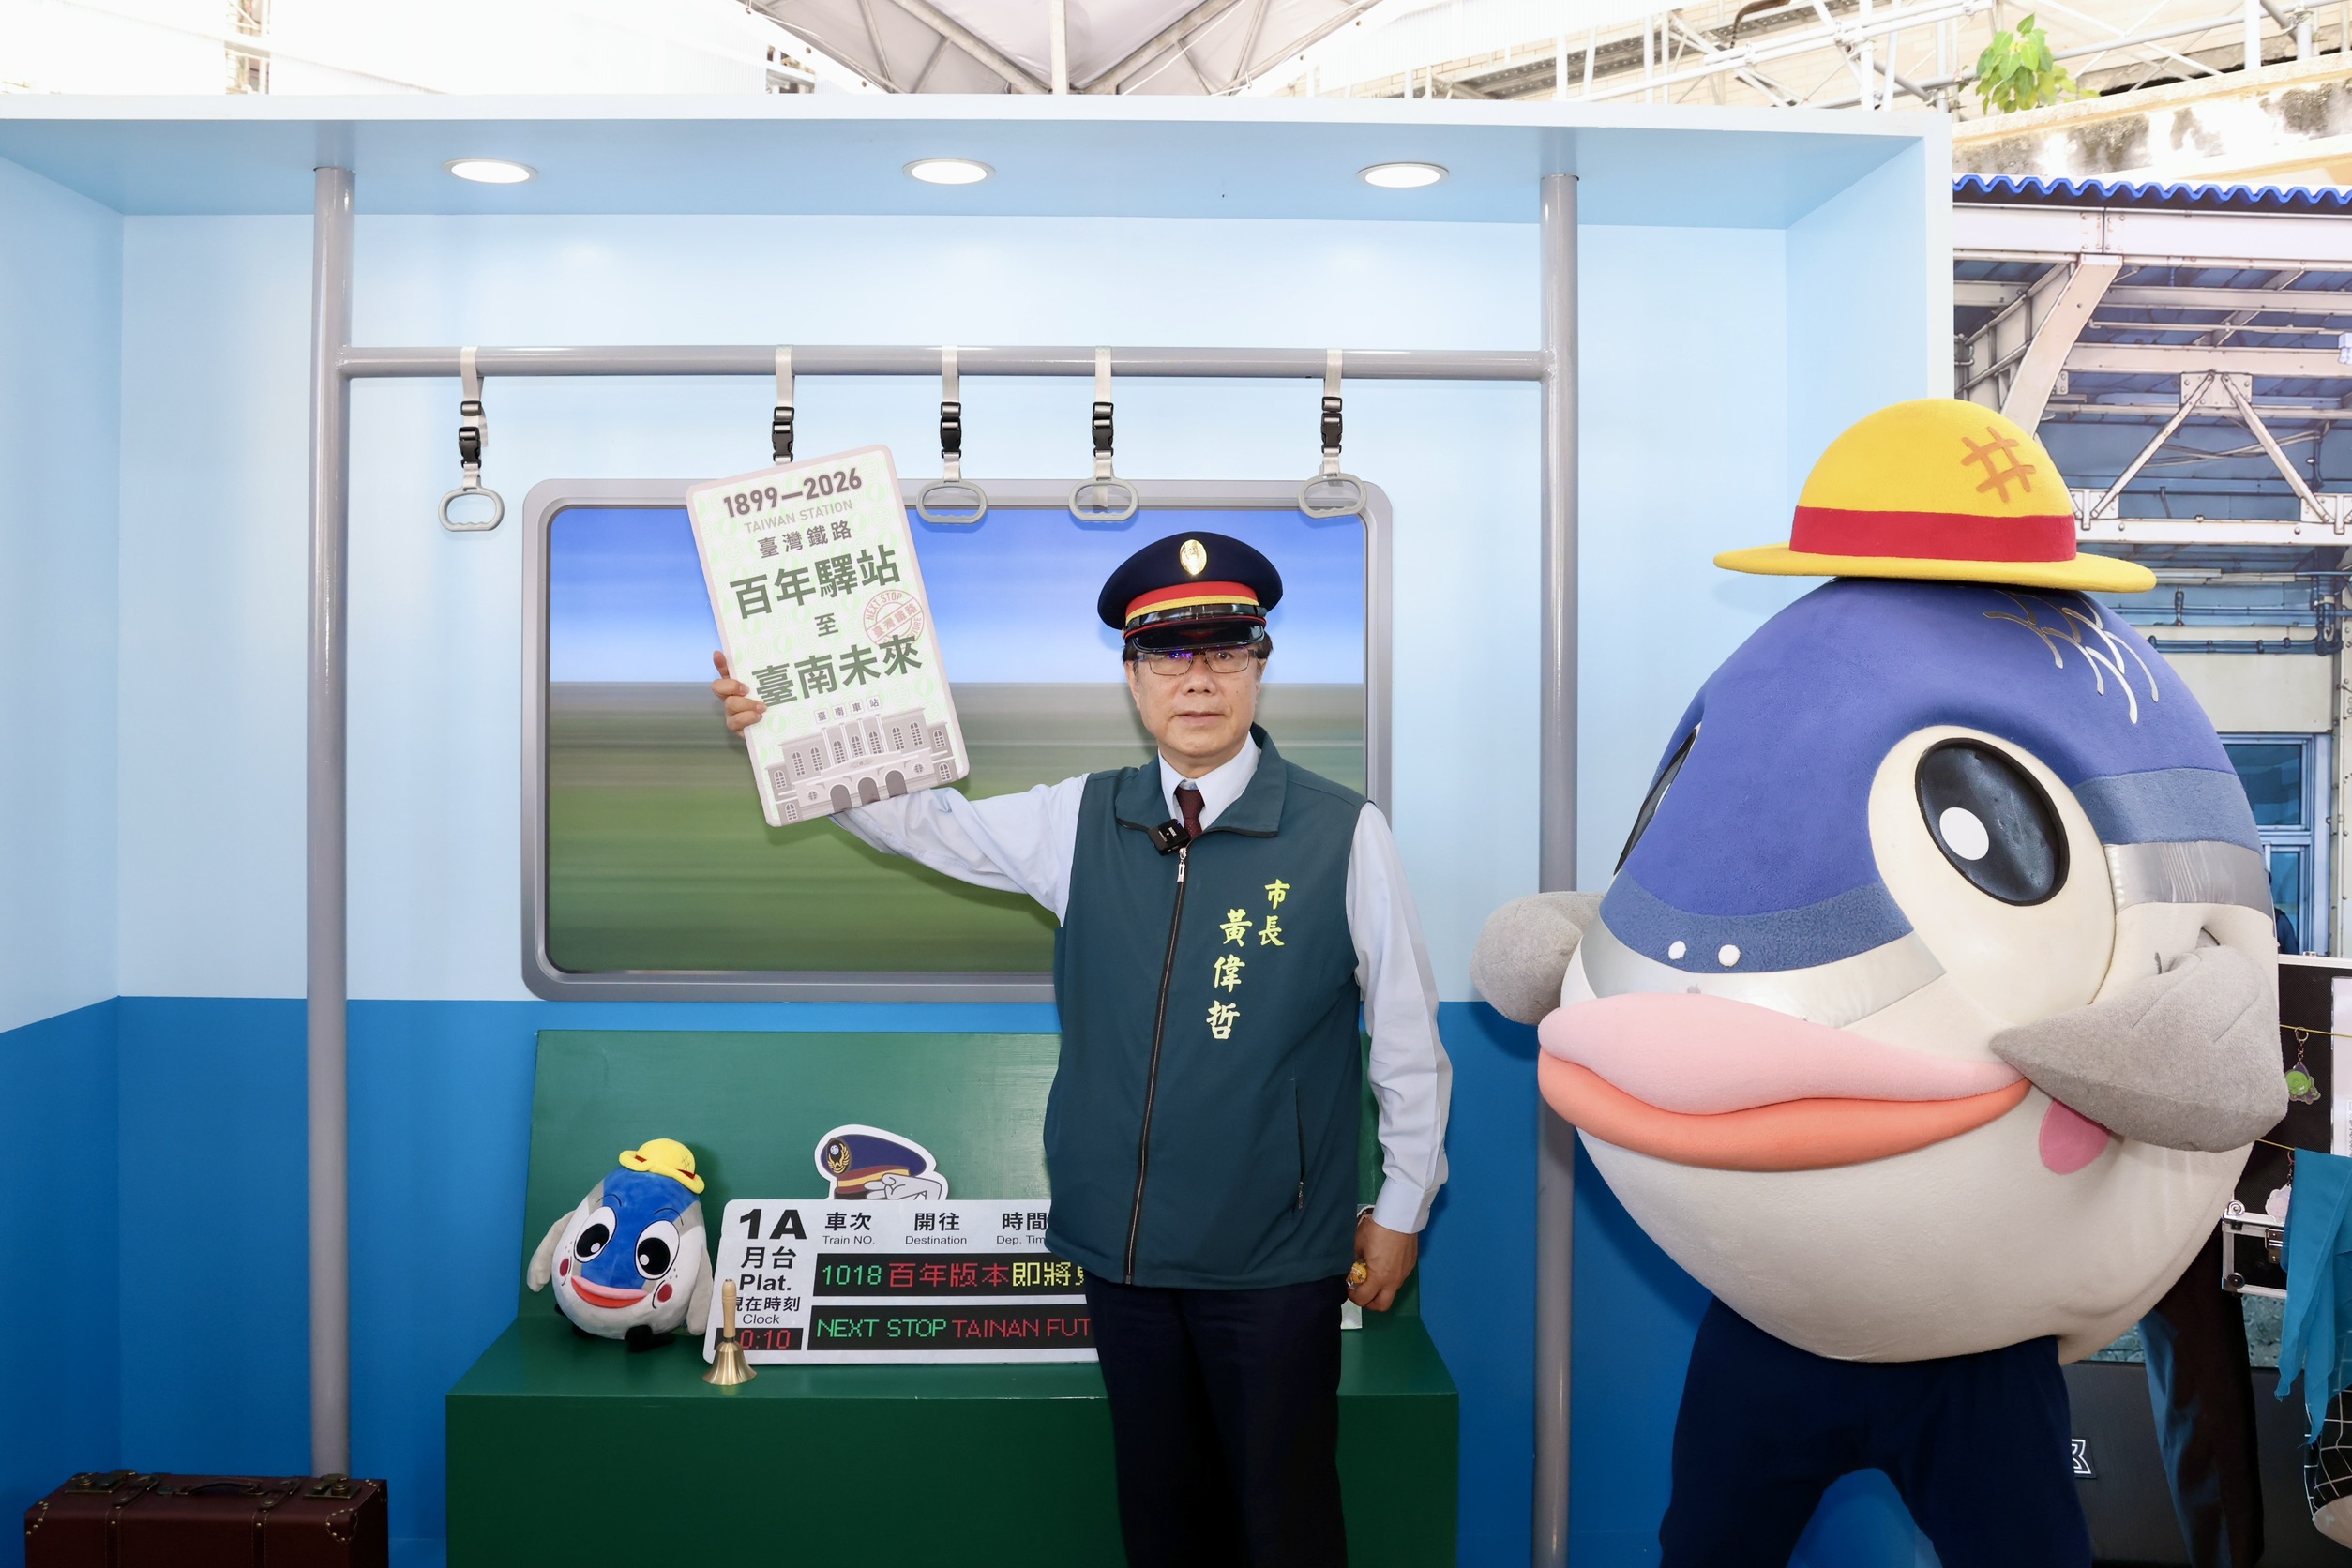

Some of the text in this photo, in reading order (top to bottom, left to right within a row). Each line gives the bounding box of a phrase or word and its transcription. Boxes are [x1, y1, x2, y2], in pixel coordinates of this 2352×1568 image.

[744, 499, 853, 534] TAIWAN STATION
[758, 520, 852, 559] 臺灣鐵路
[730, 544, 900, 619] 百年驛站
[866, 592, 902, 620] NEXT STOP
[814, 612, 839, 638] 至
[751, 635, 923, 708] 臺南未來
[817, 698, 880, 722] 臺南車站
[1258, 878, 1290, 947] 市長
[1206, 908, 1253, 1041] 黃偉哲
[739, 1208, 807, 1240] 1A
[824, 1212, 872, 1231] 車次
[914, 1212, 960, 1231] 開往
[1002, 1212, 1047, 1231] 時間
[822, 1235, 875, 1244] Train NO.
[905, 1235, 968, 1244] Destination
[996, 1235, 1022, 1245] Dep.
[740, 1245, 797, 1270] 月台
[739, 1274, 792, 1291] Plat.
[822, 1265, 882, 1285] 1018
[743, 1314, 780, 1324] Clock
[817, 1319, 880, 1337] NEXT
[886, 1319, 947, 1337] STOP
[951, 1319, 1040, 1338] TAINAN
